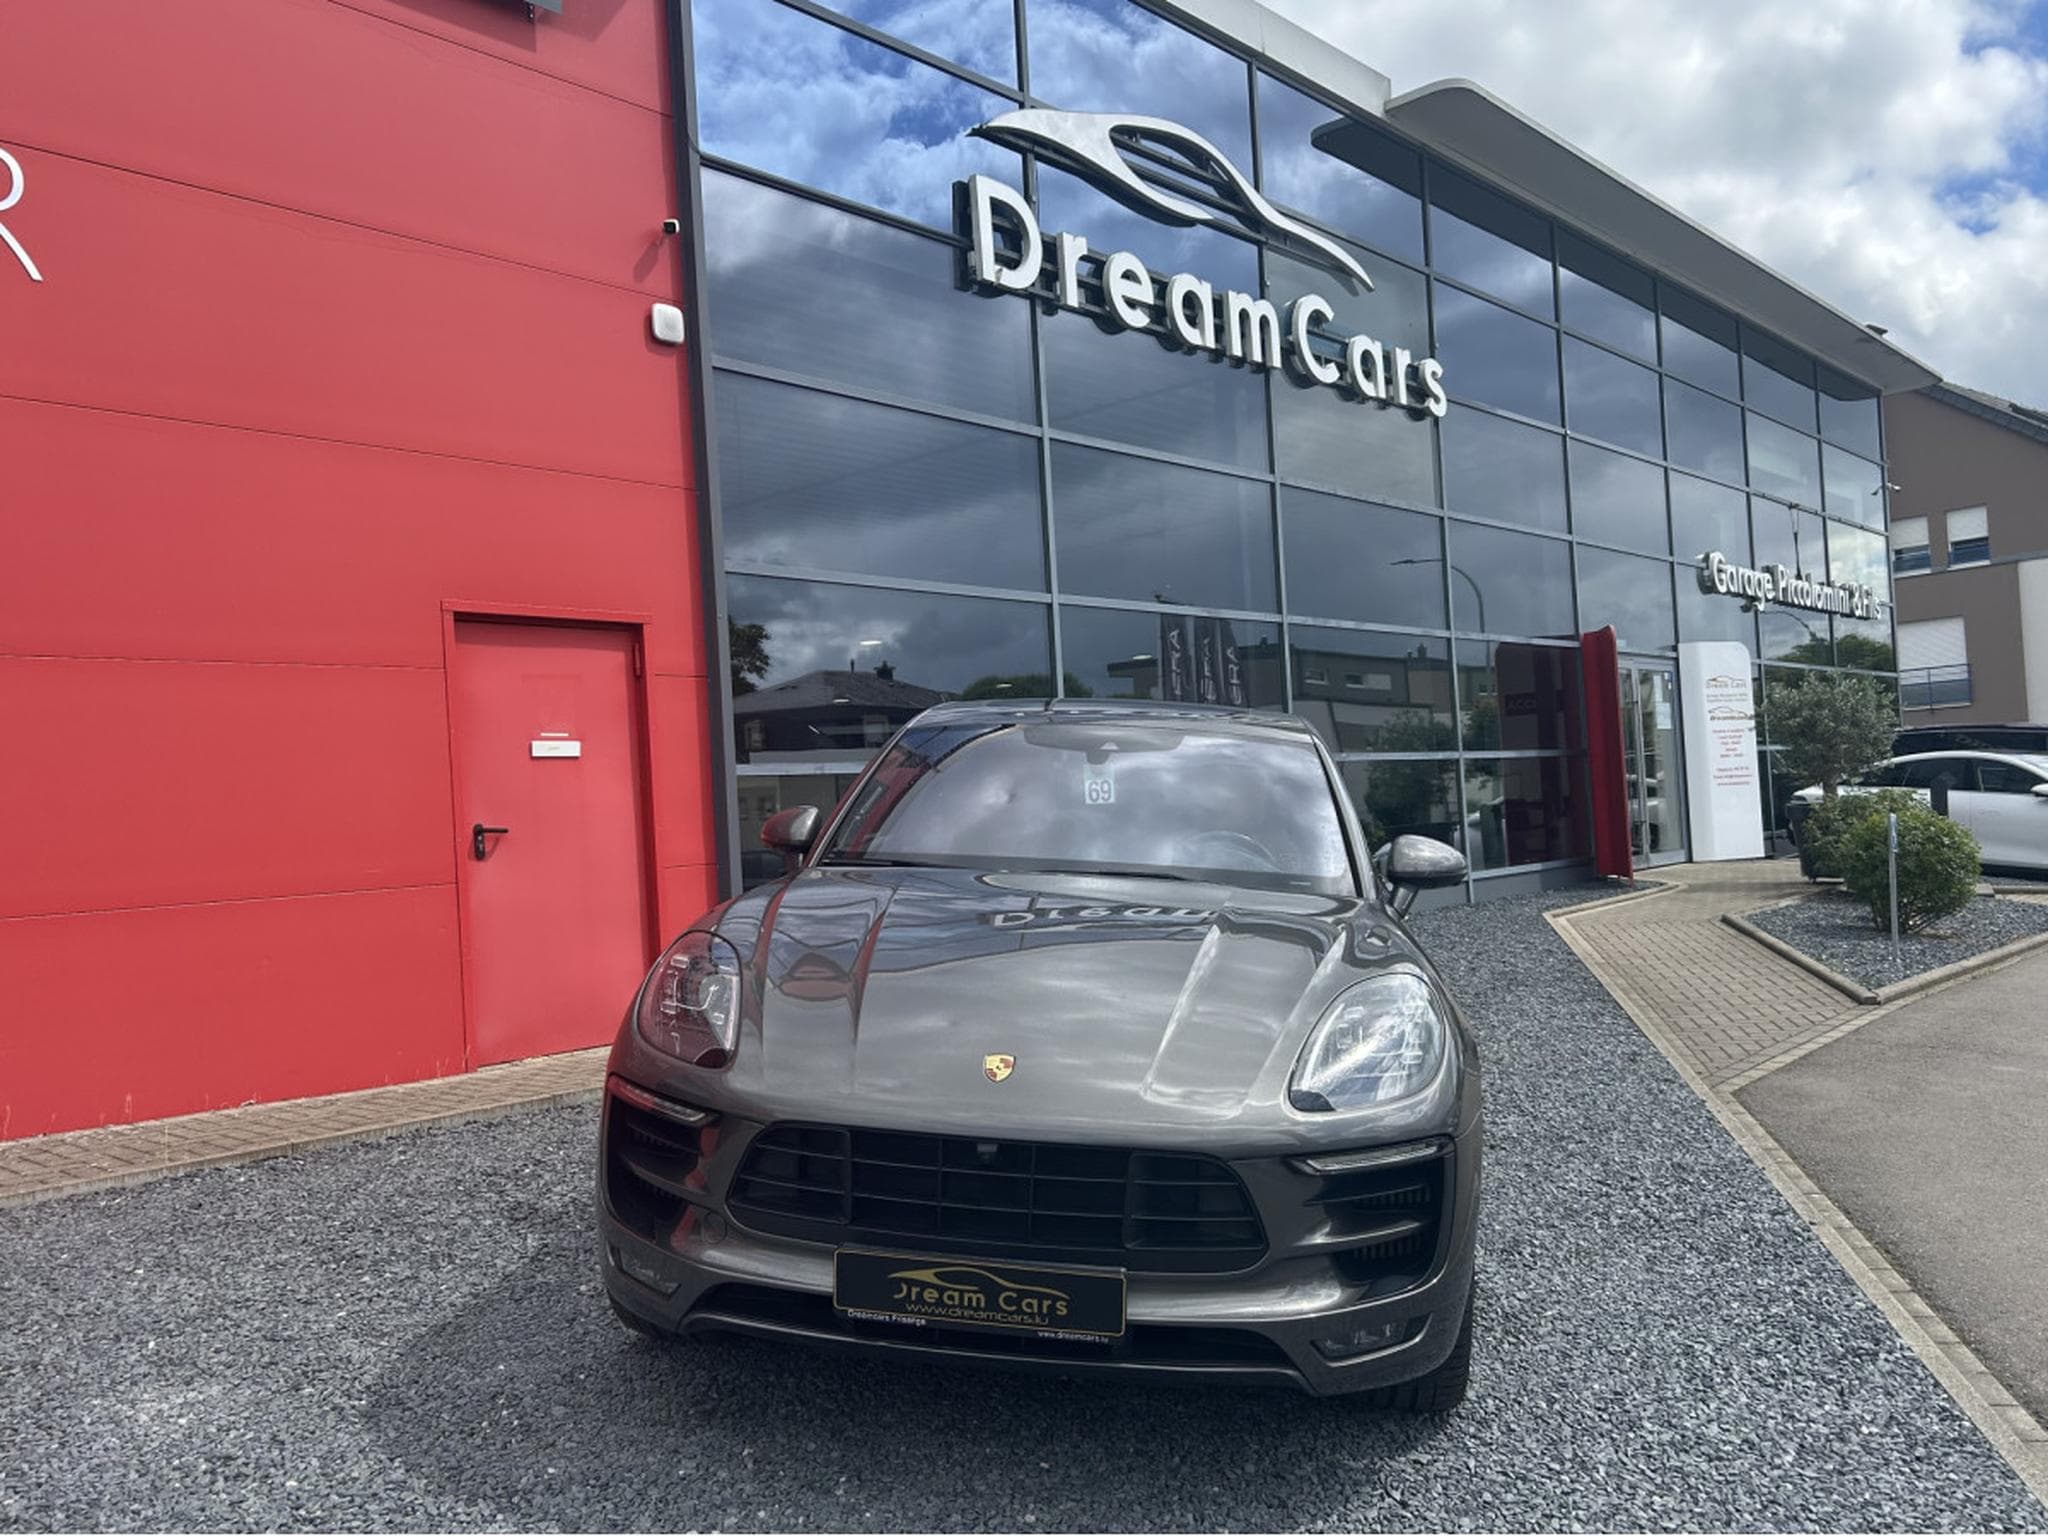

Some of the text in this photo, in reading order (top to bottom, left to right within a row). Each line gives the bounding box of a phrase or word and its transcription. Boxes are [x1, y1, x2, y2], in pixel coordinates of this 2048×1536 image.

[1709, 551, 1776, 612] Garage
[1088, 780, 1112, 803] 69
[905, 1302, 1049, 1325] www.dreamcars.lu
[999, 1290, 1069, 1316] Cars
